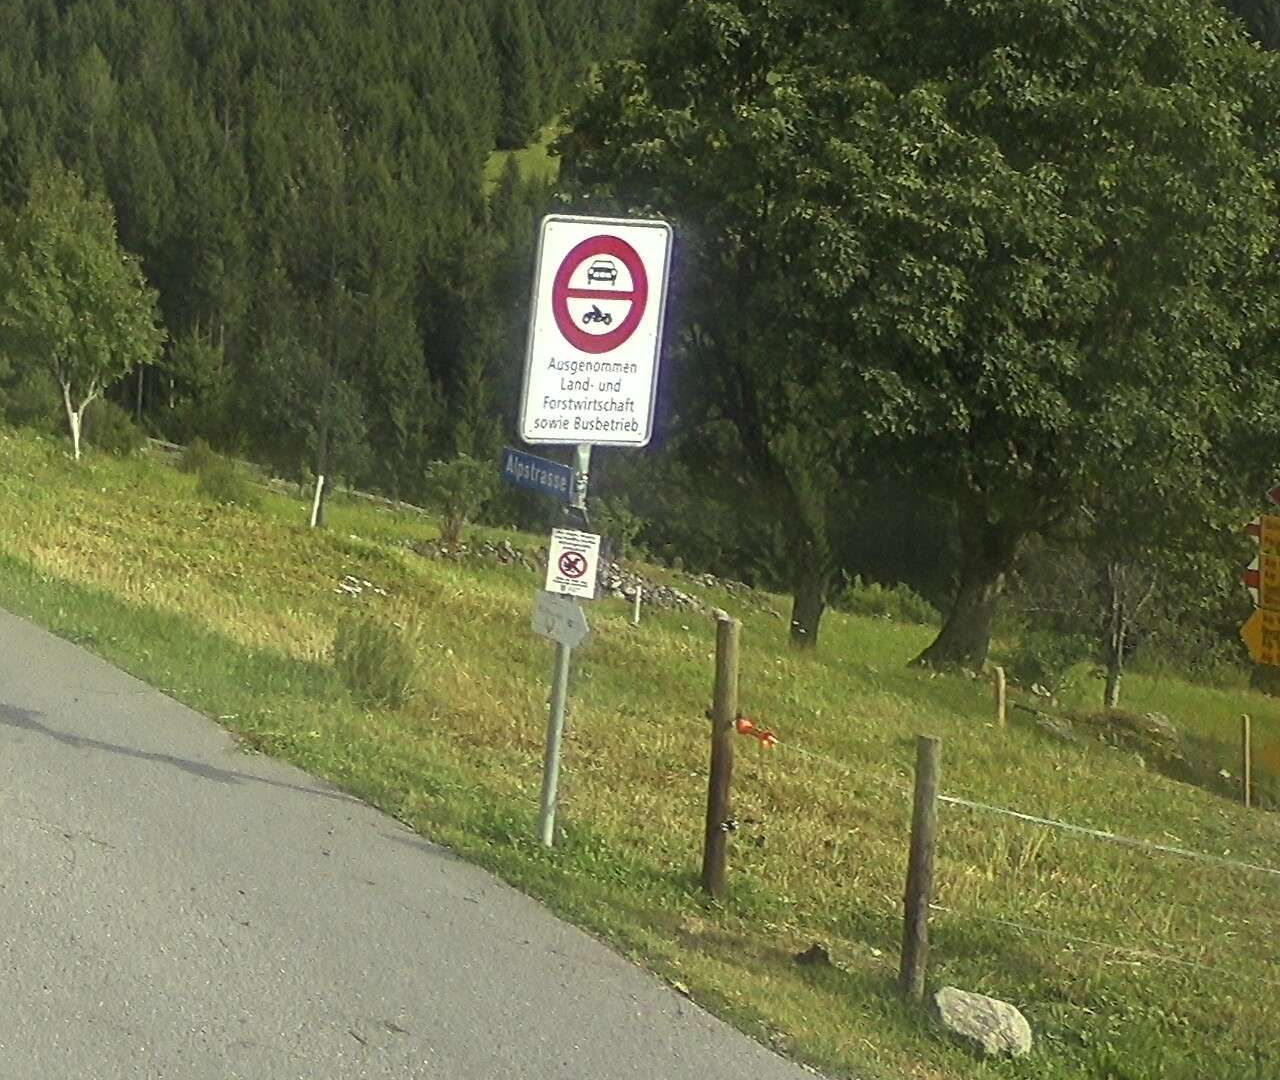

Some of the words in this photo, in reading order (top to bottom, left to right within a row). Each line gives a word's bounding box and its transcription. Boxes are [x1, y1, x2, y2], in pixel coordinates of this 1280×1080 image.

[547, 357, 637, 375] Ausgenommen
[561, 377, 594, 391] Land-
[599, 378, 621, 392] und
[543, 395, 634, 412] Forstwirtschaft
[534, 415, 570, 429] sowie
[574, 416, 639, 432] Busbetrieb
[506, 455, 566, 492] Alpstrasse
